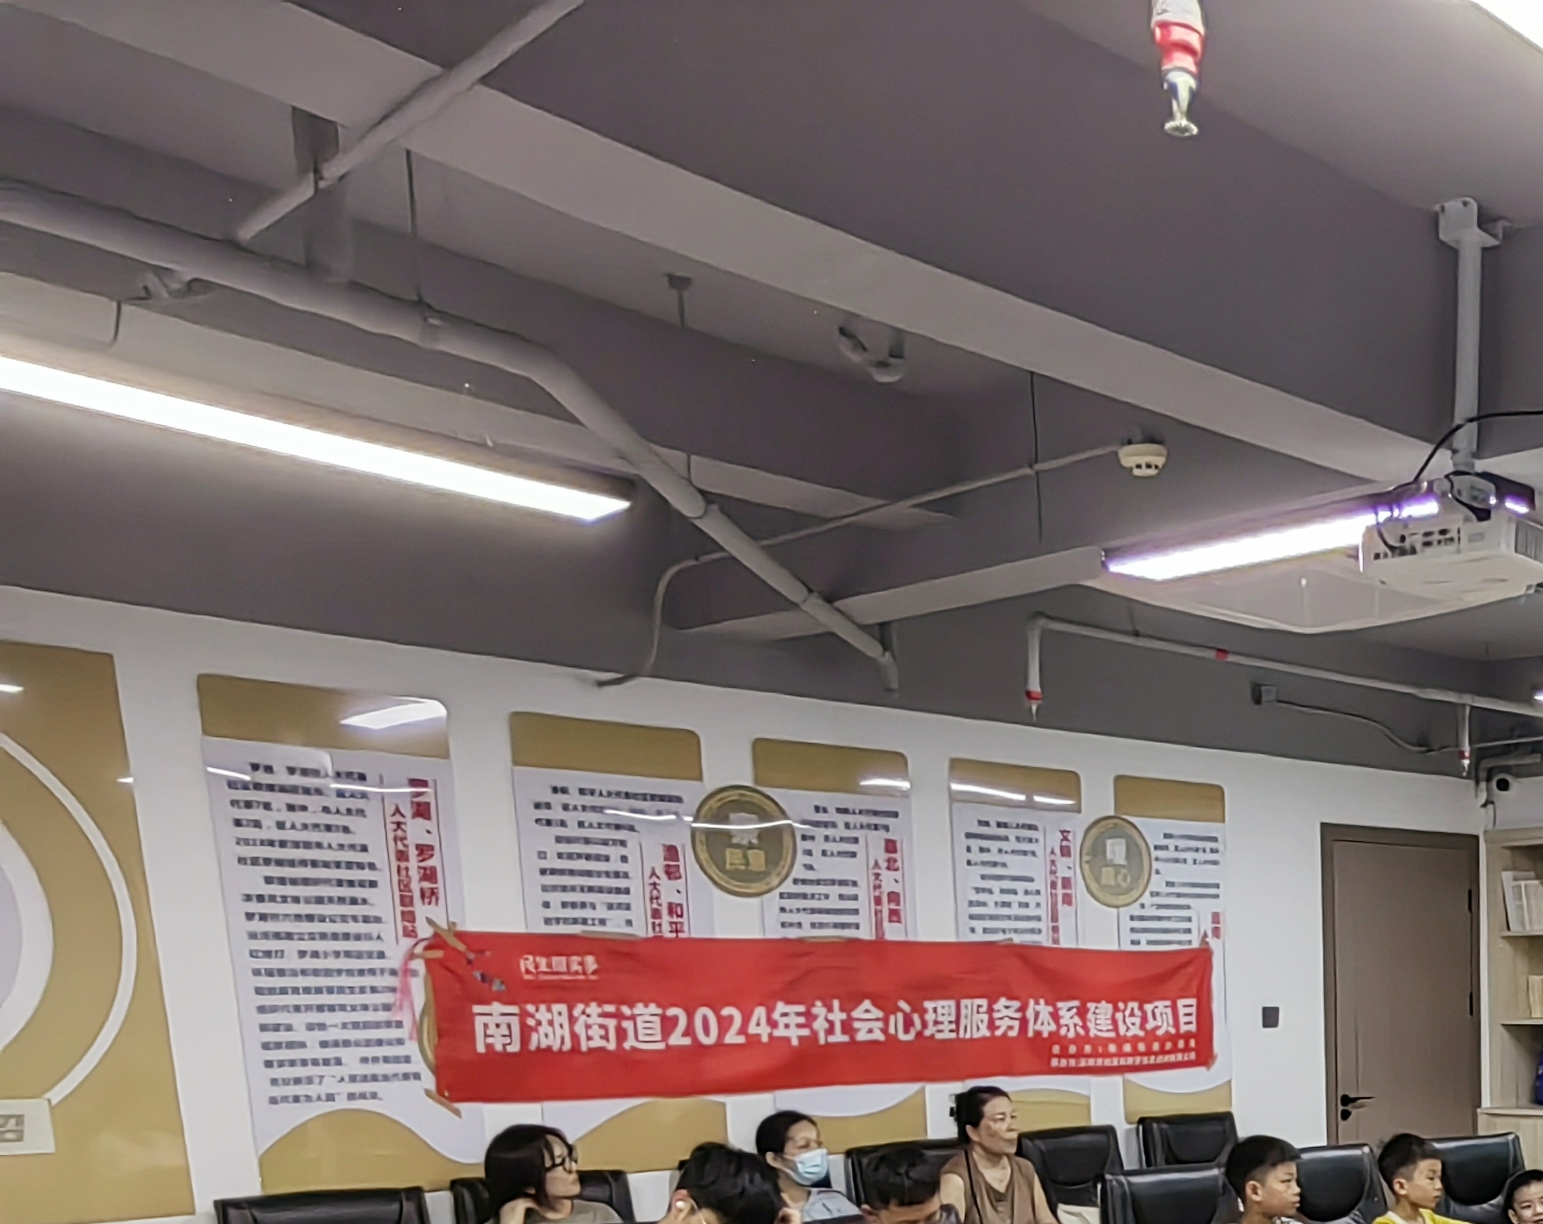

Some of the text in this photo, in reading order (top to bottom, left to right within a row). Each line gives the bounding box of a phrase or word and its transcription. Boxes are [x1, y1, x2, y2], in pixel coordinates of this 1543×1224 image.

[471, 997, 1198, 1054] 南湖街道2024年社会心理服务体系建设项目
